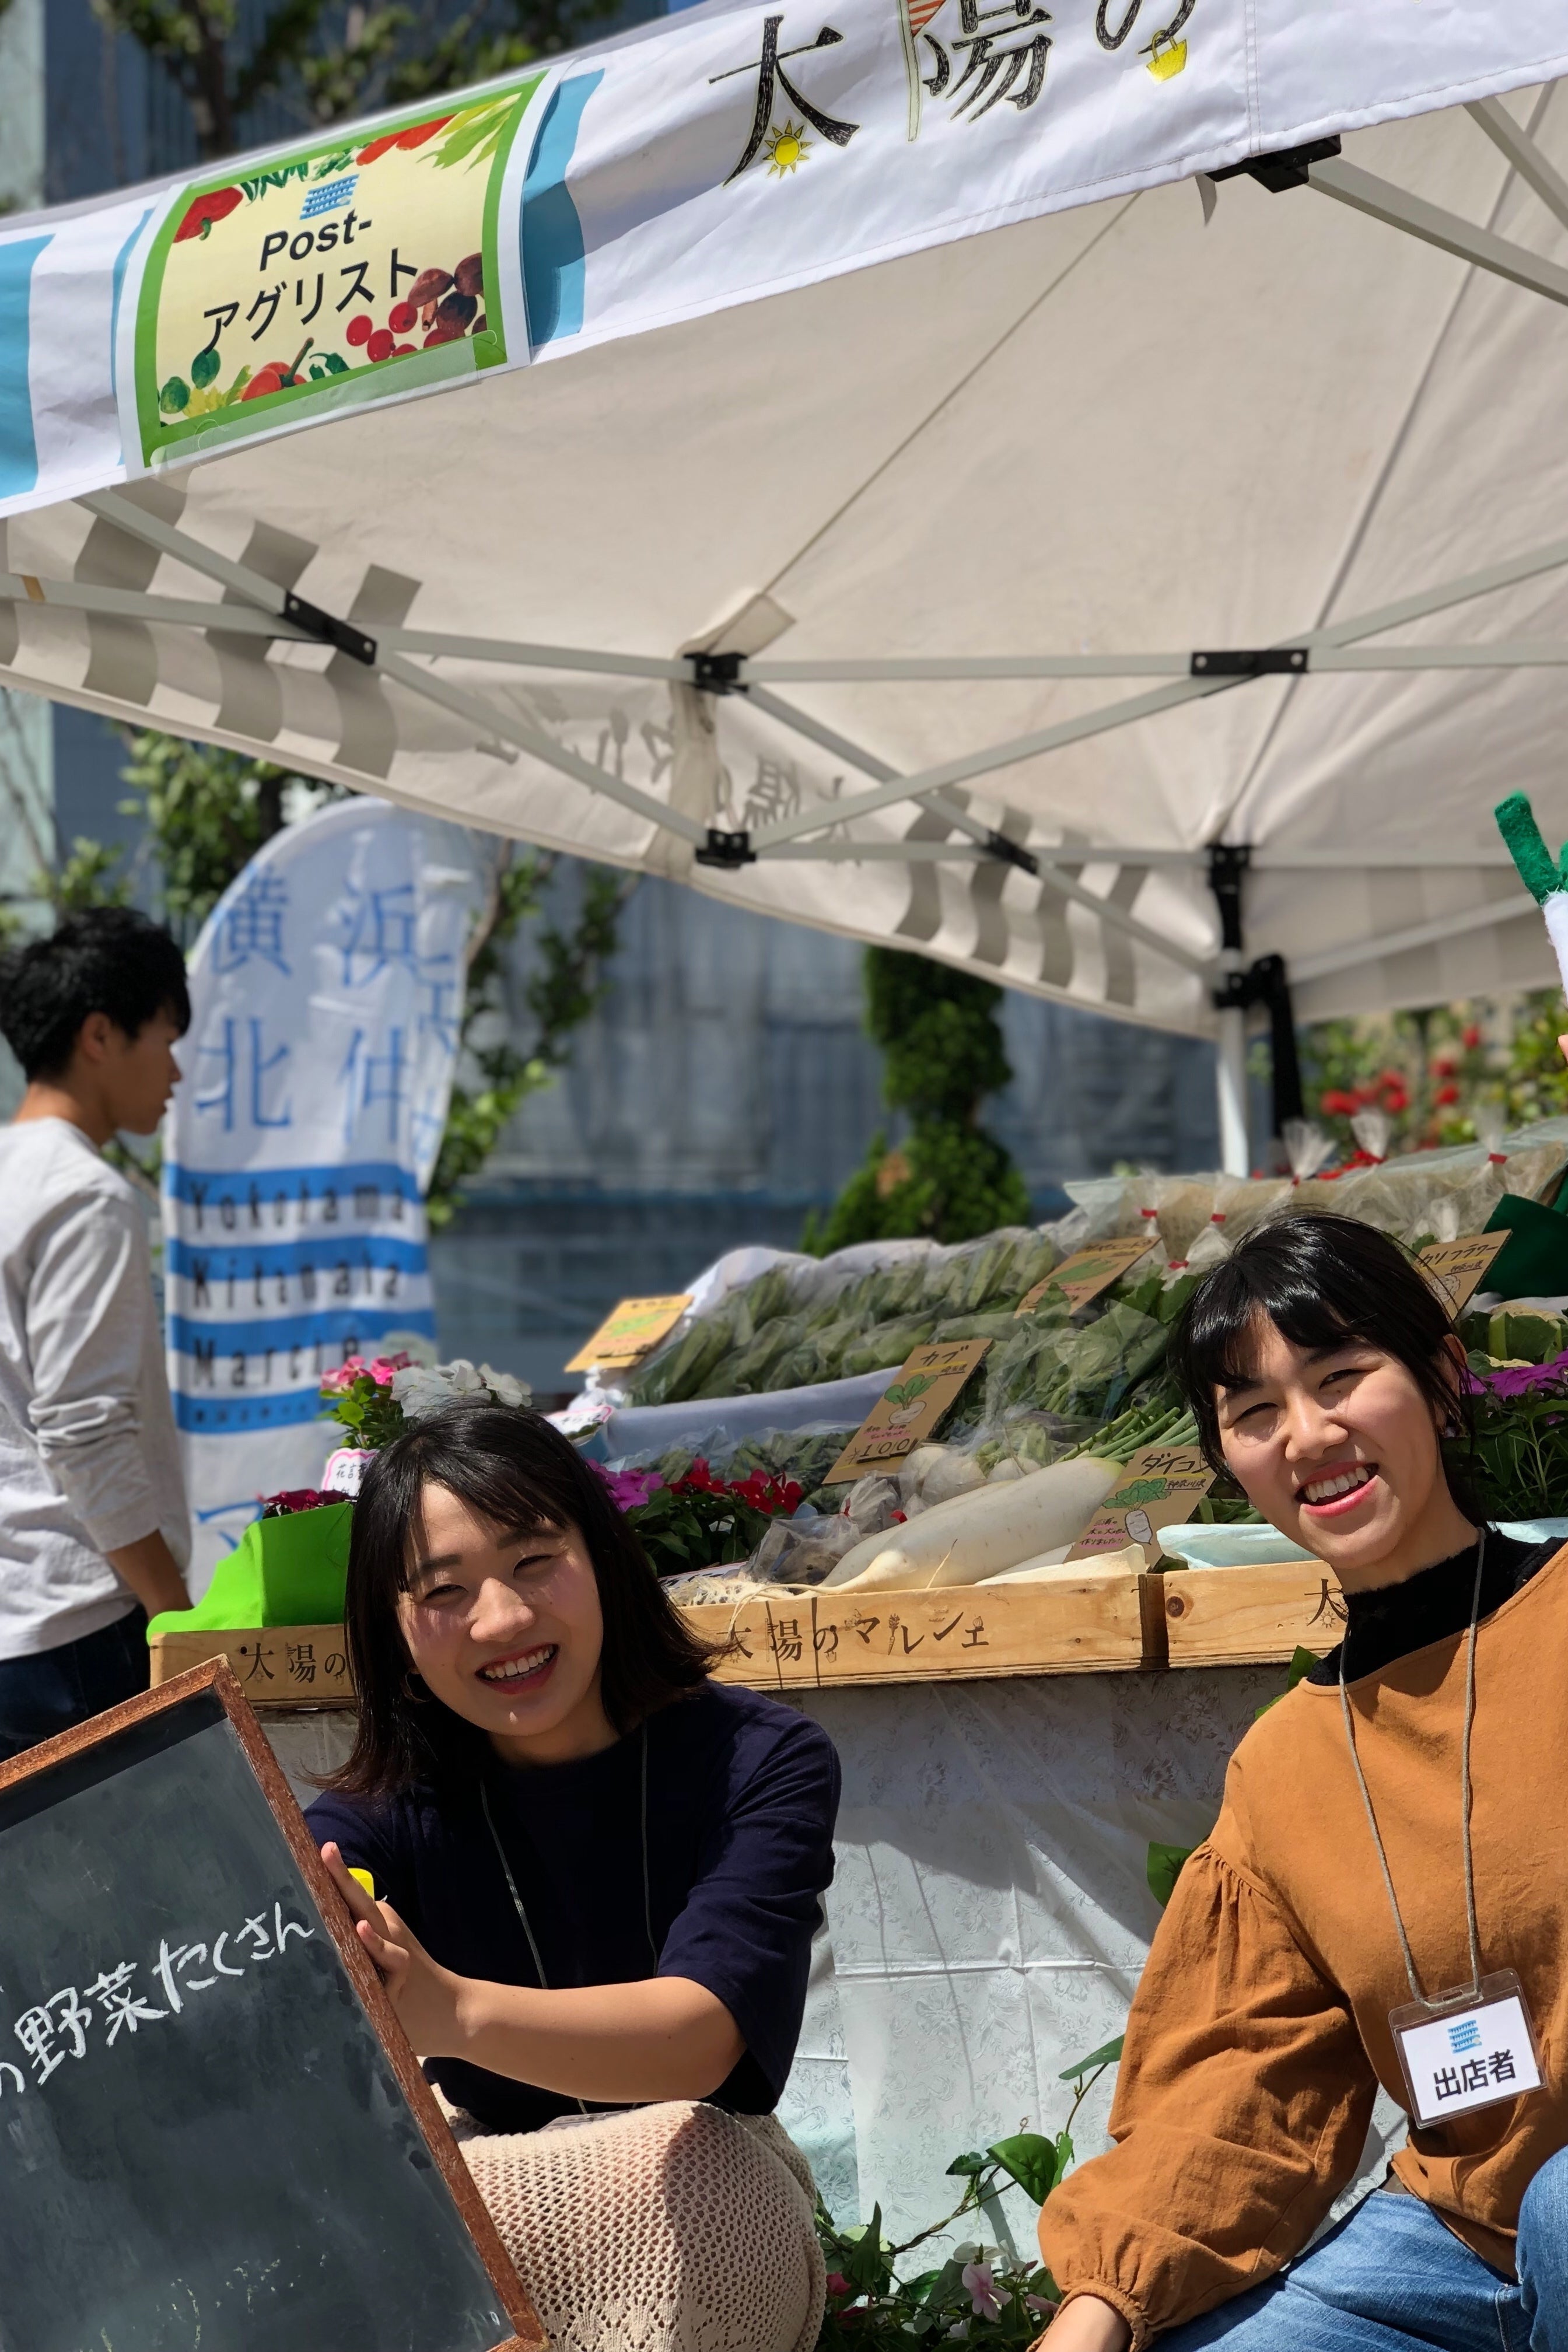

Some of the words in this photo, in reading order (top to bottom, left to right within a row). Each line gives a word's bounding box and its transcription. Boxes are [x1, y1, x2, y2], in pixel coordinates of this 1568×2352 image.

[259, 208, 373, 271] Post-
[203, 248, 419, 353] アグリスト
[1418, 1242, 1500, 1268] カリフラワー
[921, 1344, 970, 1367] カブ
[1140, 1452, 1210, 1476] ダイコン
[1433, 2049, 1517, 2101] 出店者
